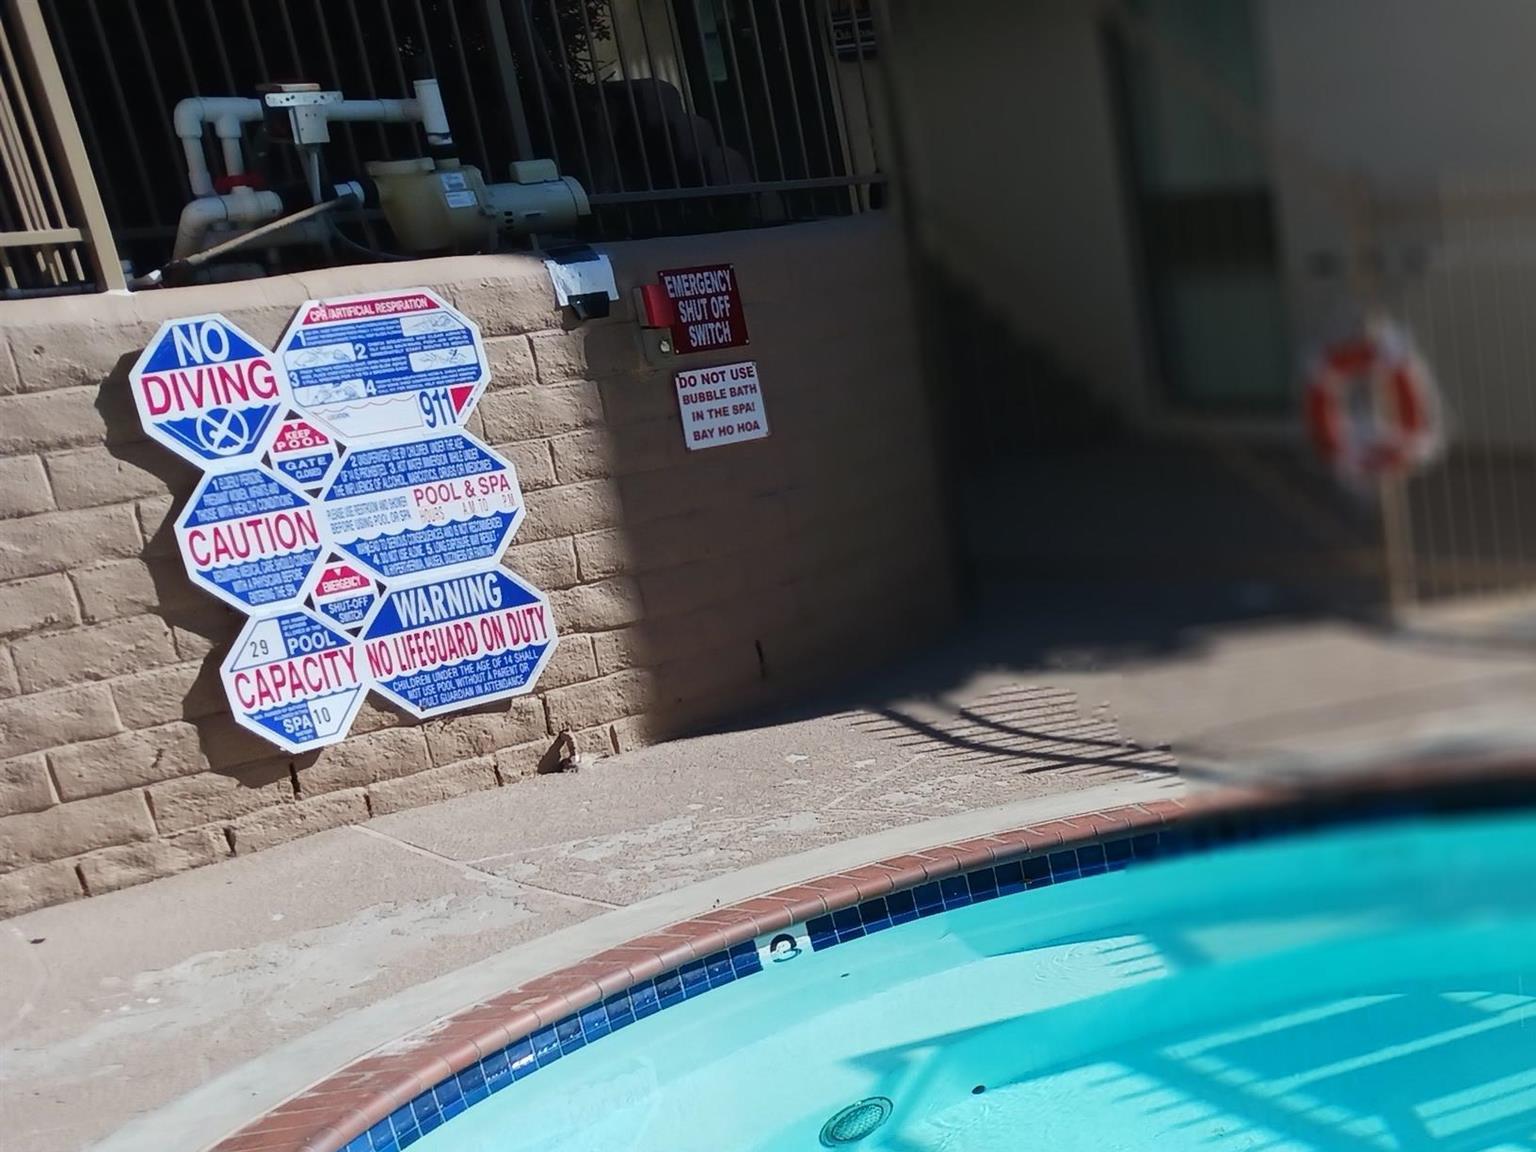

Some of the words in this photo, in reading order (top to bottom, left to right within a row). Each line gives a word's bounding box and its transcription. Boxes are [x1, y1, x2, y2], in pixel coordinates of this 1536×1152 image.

[664, 270, 732, 298] EMERGENCY
[375, 298, 429, 314] RESPIRATION
[678, 298, 708, 323] SHUT
[710, 295, 730, 319] OFF
[172, 320, 230, 367] NO
[688, 321, 732, 347] SWITCH
[141, 359, 279, 416] DIVING
[679, 375, 697, 389] DO
[701, 370, 726, 385] NOT
[730, 366, 755, 381] USE
[419, 387, 456, 429] 911
[682, 388, 727, 405] BUBBLE
[729, 384, 757, 397] BATH
[692, 410, 704, 422] IN
[707, 406, 729, 419] THE
[732, 402, 755, 415] SPA!
[276, 436, 325, 451] POOL
[284, 429, 310, 441] KEEP
[693, 428, 714, 441] BAY
[718, 425, 734, 437] HO
[737, 420, 760, 433] HOA
[285, 456, 327, 471] GATE
[413, 482, 462, 507] POOL
[465, 479, 476, 498] &
[478, 473, 511, 495] SPA
[188, 510, 319, 566] CAUTION
[328, 596, 368, 614] SHUT-OFF
[392, 573, 503, 628] WARNING
[250, 639, 270, 658] 29
[287, 630, 337, 656] POOL
[365, 640, 393, 679] NO
[393, 621, 478, 672] LIFEGUARD
[480, 615, 507, 652] ON
[506, 605, 548, 646] DUTY
[234, 645, 358, 710] CAPACITY
[393, 673, 431, 691] CHILDREN
[431, 668, 458, 682] UNDER
[459, 662, 474, 676] THE
[475, 658, 491, 673] AGE
[492, 656, 502, 668] OF
[503, 653, 513, 665] 14
[514, 648, 539, 664] SHALL
[422, 683, 436, 697] USE
[436, 679, 455, 692] POOL
[455, 670, 486, 688] WITHOUT
[493, 663, 518, 680] PARENT
[518, 662, 531, 674] OR
[440, 685, 475, 704] GUARDIAN
[484, 673, 525, 693] ATTENDANCE
[282, 713, 313, 734] SPA
[313, 706, 331, 725] 10
[769, 933, 802, 963] 3
